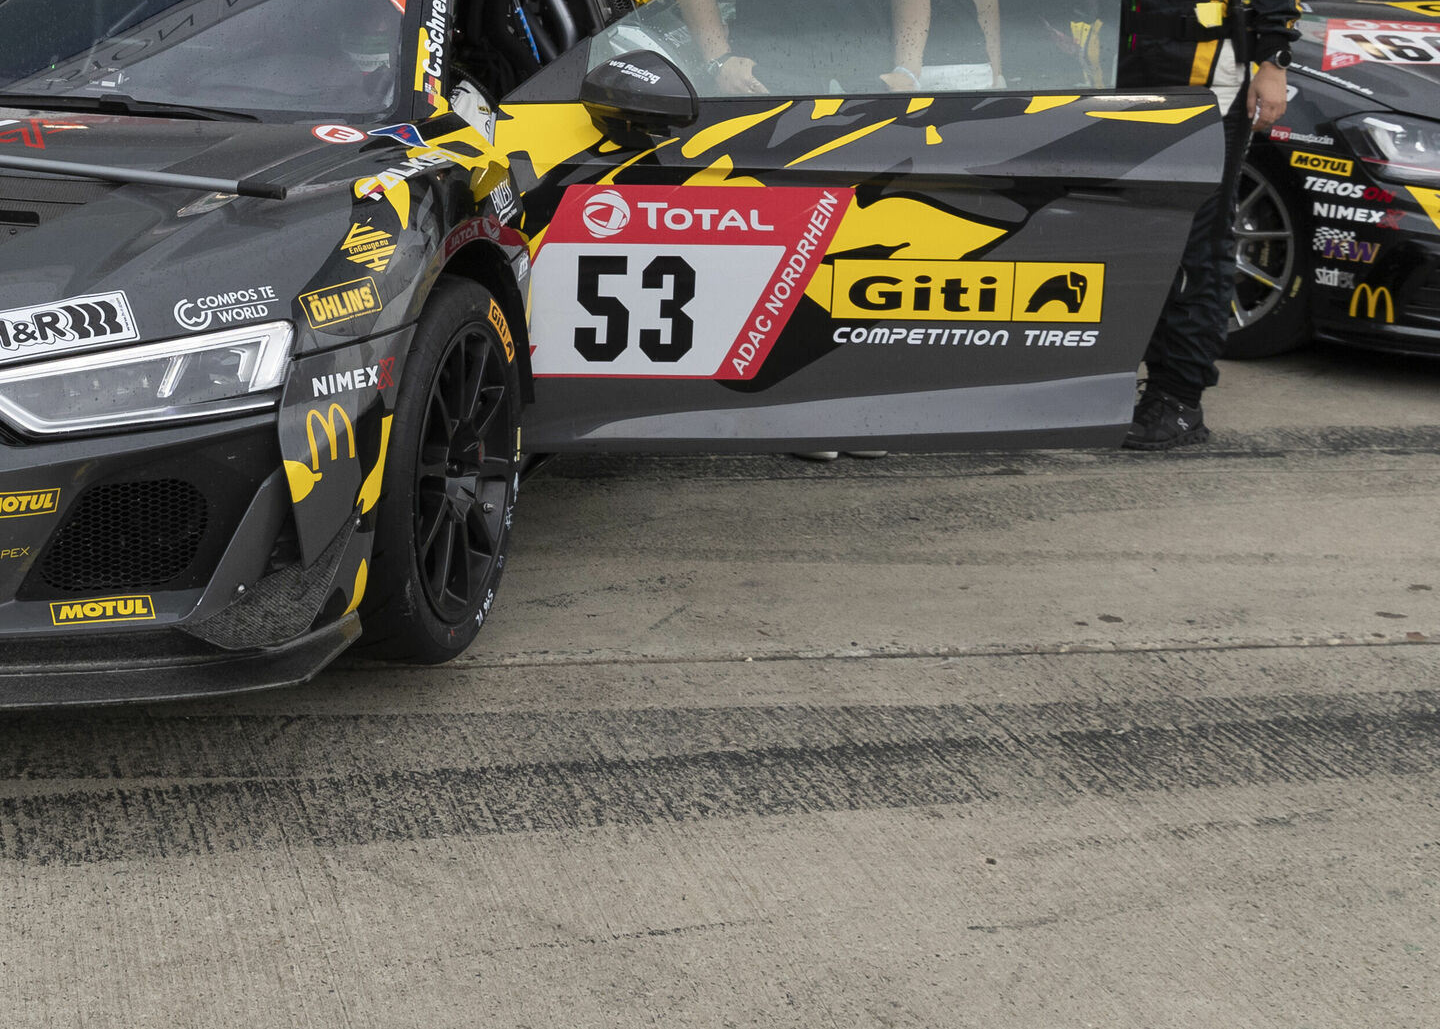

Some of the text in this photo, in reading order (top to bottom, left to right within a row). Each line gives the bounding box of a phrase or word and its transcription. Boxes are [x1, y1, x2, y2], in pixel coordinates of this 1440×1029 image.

[1293, 154, 1349, 173] MOTUL
[1304, 175, 1396, 204] TEROSON
[637, 200, 774, 233] TOTAL
[348, 238, 389, 255] EnGauge.eu
[732, 190, 839, 375] ADAC NORDRHEIN
[847, 274, 998, 314] Giti
[218, 304, 268, 324] WORLD
[309, 285, 375, 323] ÖHLINS
[573, 255, 696, 363] 53
[832, 327, 1100, 347] COMPETITION TIRES
[59, 599, 149, 621] MOTUL
